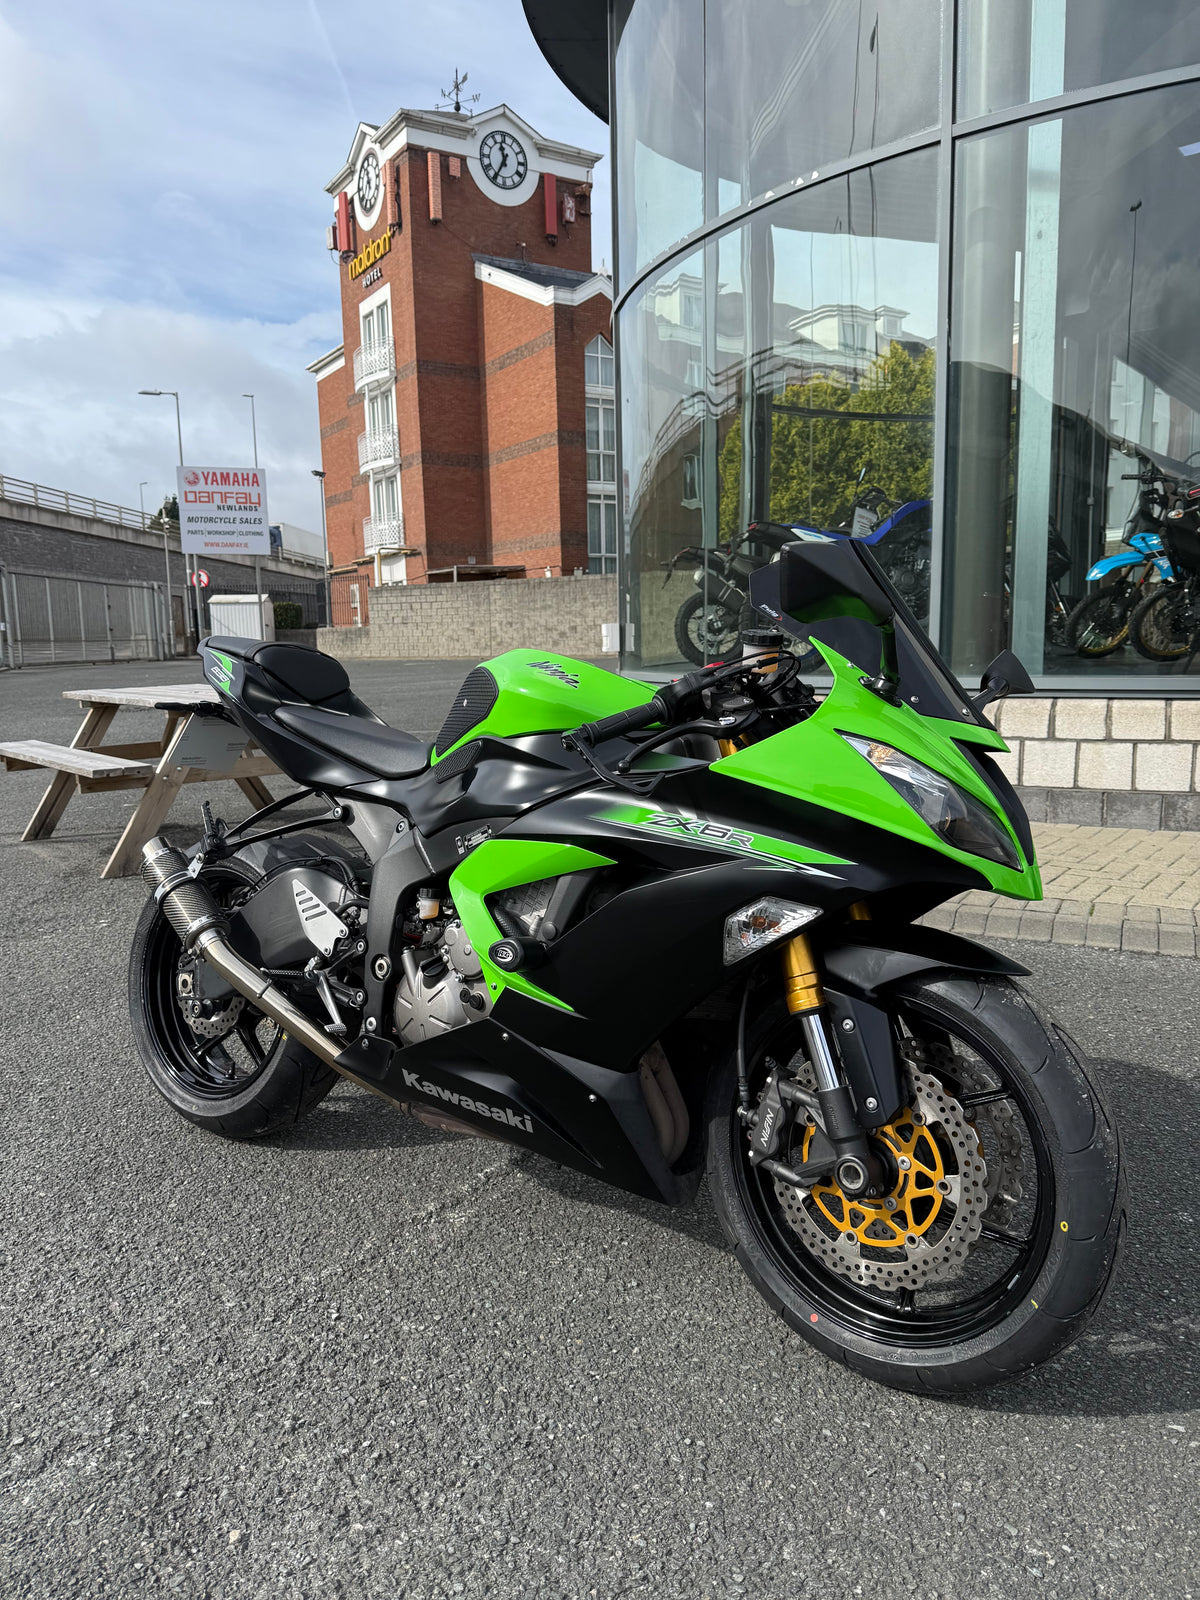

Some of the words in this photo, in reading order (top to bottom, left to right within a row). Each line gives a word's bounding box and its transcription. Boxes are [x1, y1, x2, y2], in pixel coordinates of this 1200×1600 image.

[348, 233, 391, 281] maldron
[362, 267, 383, 288] HOTEL
[201, 471, 260, 487] YAMAHA
[187, 516, 237, 525] MOTORCYCLE
[239, 517, 263, 525] SALES
[216, 504, 258, 512] NEWLANDS
[207, 529, 236, 537] WORKSHOP
[525, 660, 580, 689] Ninja
[646, 812, 754, 849] ZX-6R
[401, 1067, 534, 1134] Kawasaki
[760, 1107, 775, 1148] NISSIN
